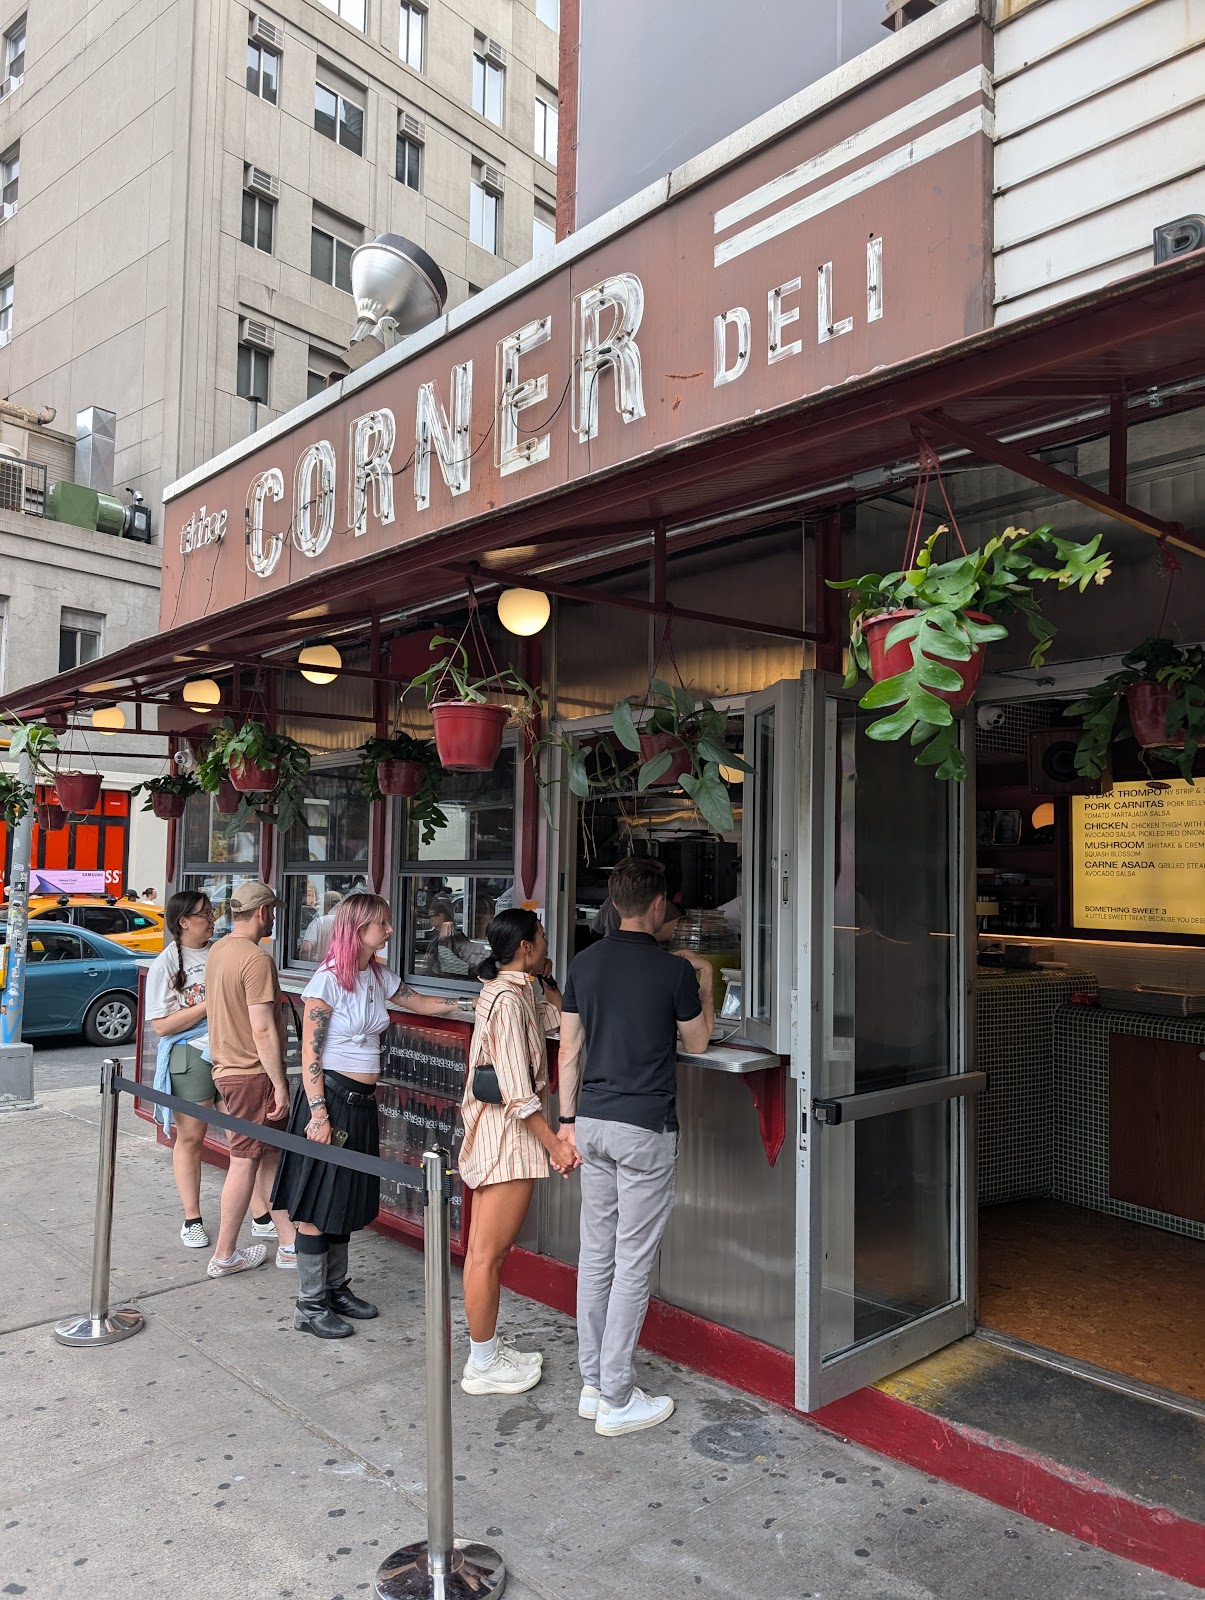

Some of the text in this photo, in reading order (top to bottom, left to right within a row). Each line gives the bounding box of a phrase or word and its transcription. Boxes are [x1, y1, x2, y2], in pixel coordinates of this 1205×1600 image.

[713, 236, 884, 388] DELI
[245, 271, 647, 578] CORNER
[1117, 788, 1162, 798] TROMPO
[1084, 802, 1111, 810] PORK
[1114, 800, 1164, 810] CARNITAS
[1084, 822, 1128, 830] CHICKEN
[1084, 841, 1145, 850] MUSHROOM
[1084, 860, 1118, 868] CARNE
[1084, 906, 1130, 914] SOMETHING
